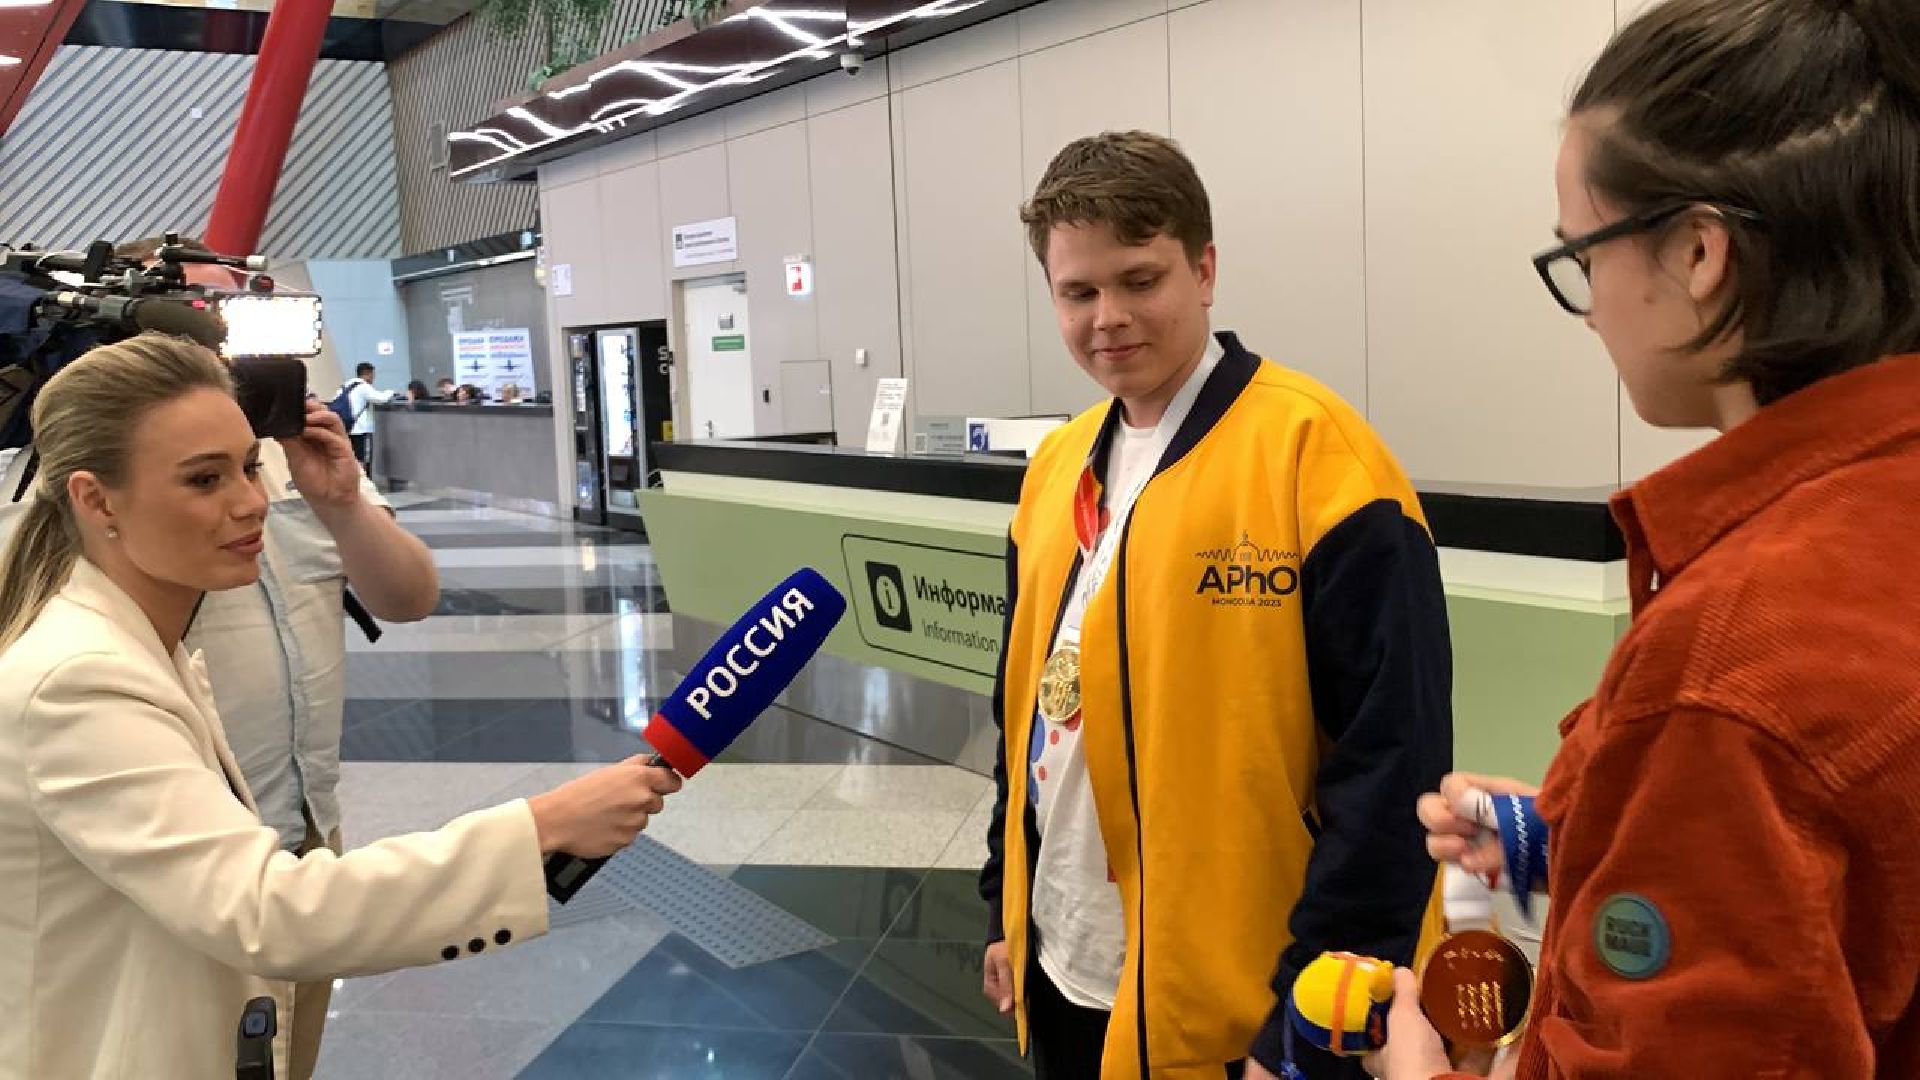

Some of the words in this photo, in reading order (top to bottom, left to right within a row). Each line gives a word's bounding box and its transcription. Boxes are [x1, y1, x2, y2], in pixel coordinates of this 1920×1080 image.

[1196, 565, 1297, 595] APhO
[1212, 597, 1256, 607] MONGOLIA
[686, 587, 815, 721] РОССИЯ
